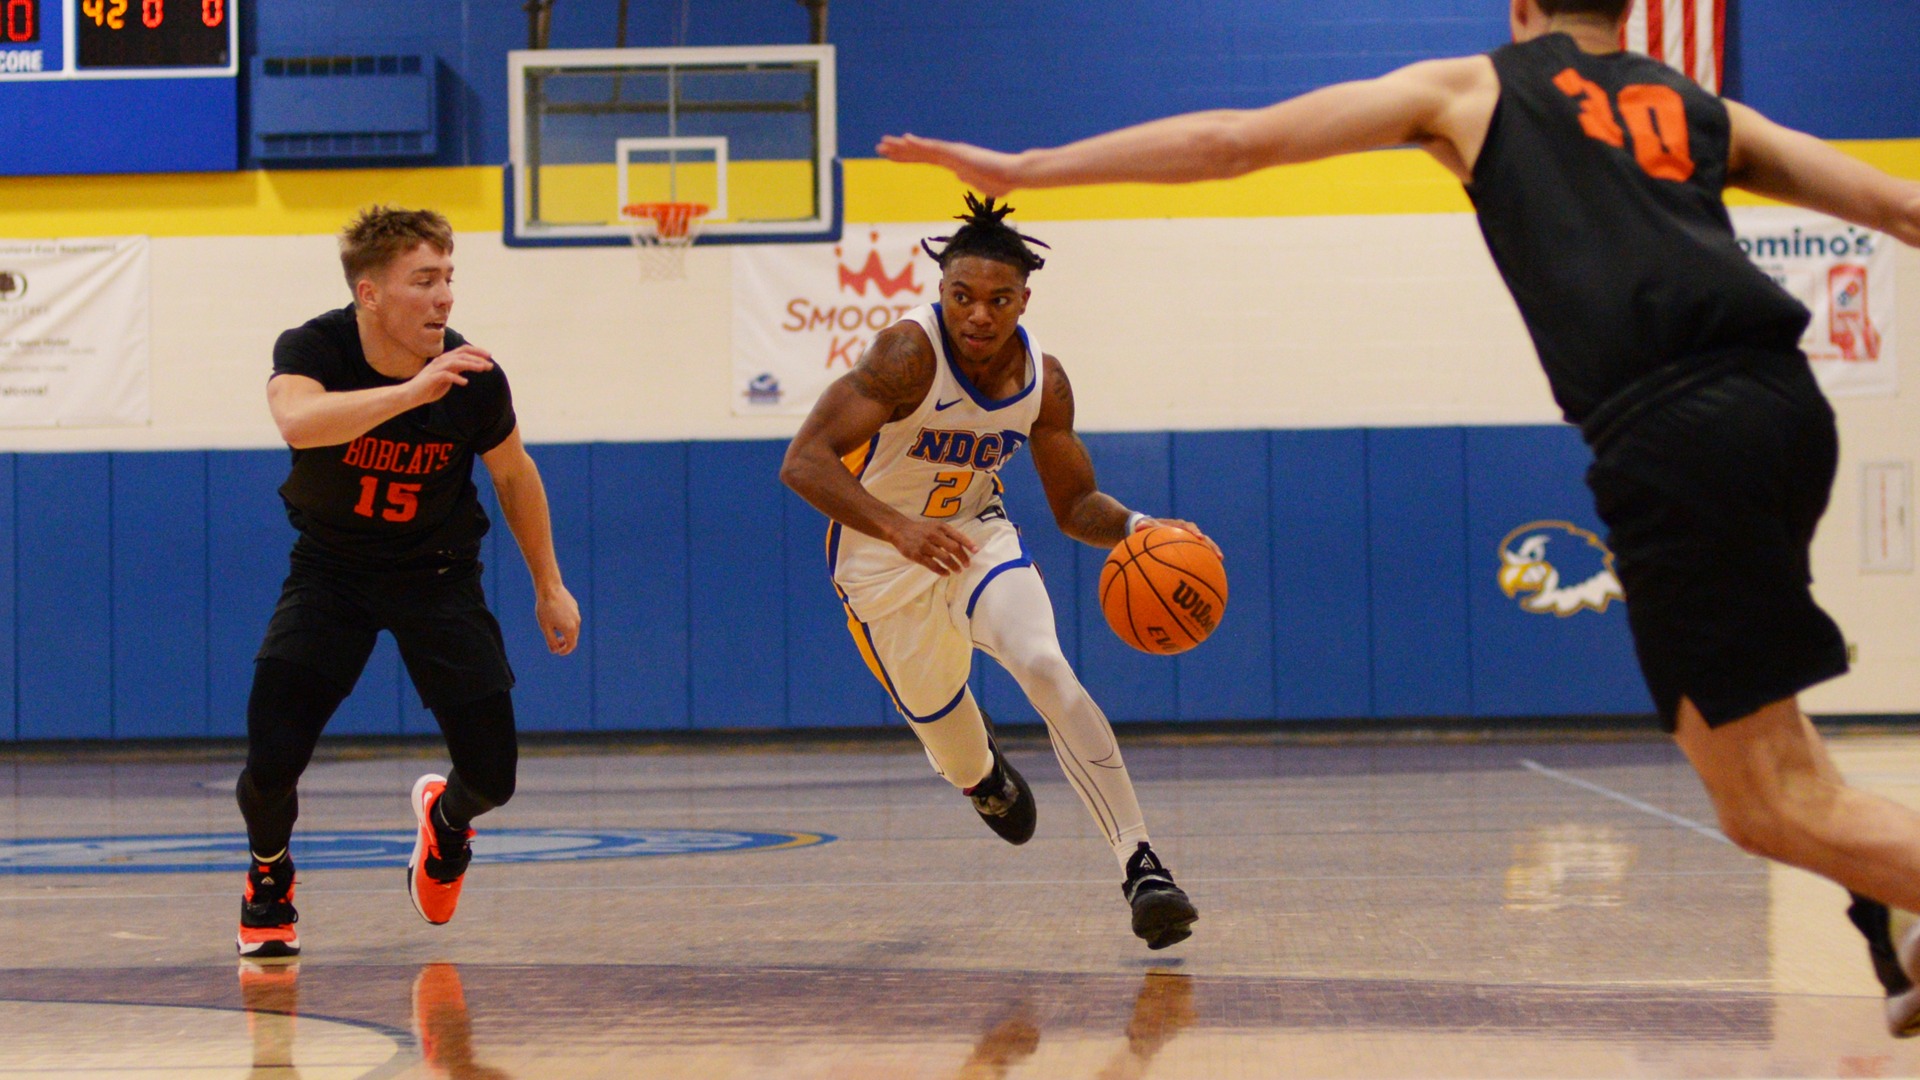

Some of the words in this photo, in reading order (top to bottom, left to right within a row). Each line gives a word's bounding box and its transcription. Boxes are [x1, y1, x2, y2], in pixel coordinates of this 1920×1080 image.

[0, 0, 33, 42] 0
[82, 0, 128, 30] 42
[142, 0, 164, 28] 0
[202, 0, 224, 27] 0
[1552, 67, 1695, 183] 30
[342, 436, 454, 474] BOBCATS
[354, 475, 423, 522] 15
[921, 472, 975, 518] 2
